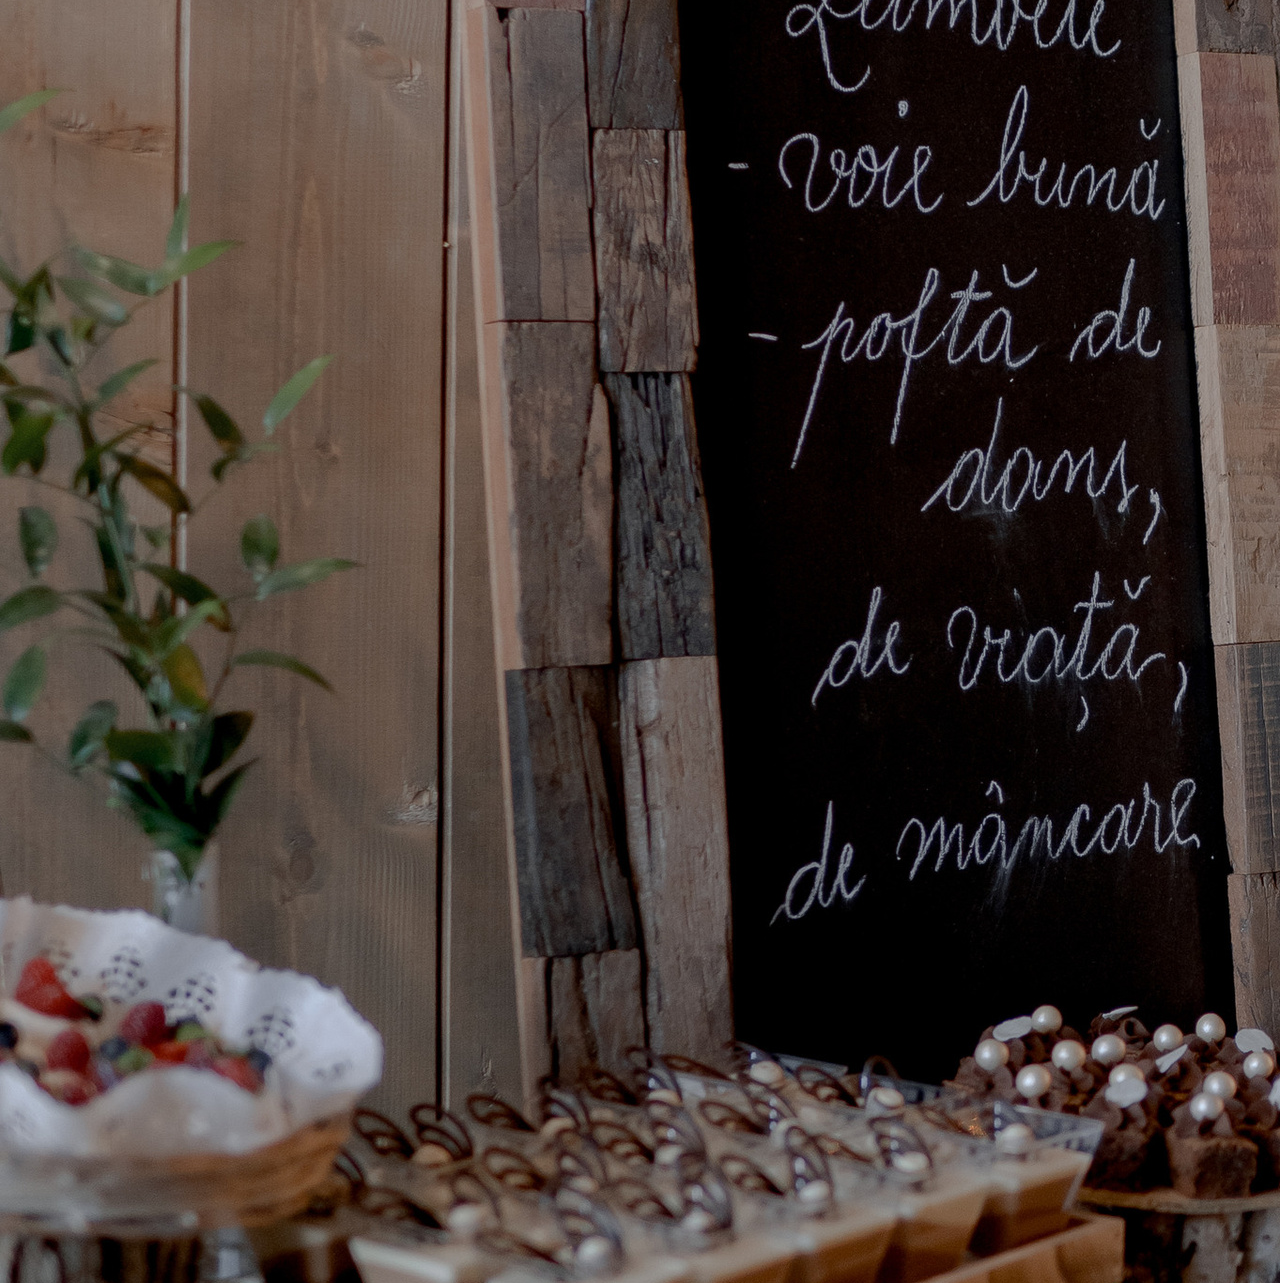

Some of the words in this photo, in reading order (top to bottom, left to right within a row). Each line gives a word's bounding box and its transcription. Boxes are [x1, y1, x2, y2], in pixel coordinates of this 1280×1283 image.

[778, 100, 944, 213] voie
[967, 85, 1166, 220] bună
[791, 264, 1038, 470] poftă
[1070, 258, 1161, 362] de
[921, 397, 1163, 545] dans,
[811, 586, 913, 706] de
[769, 800, 867, 926] de
[896, 778, 1200, 881] mâncare
